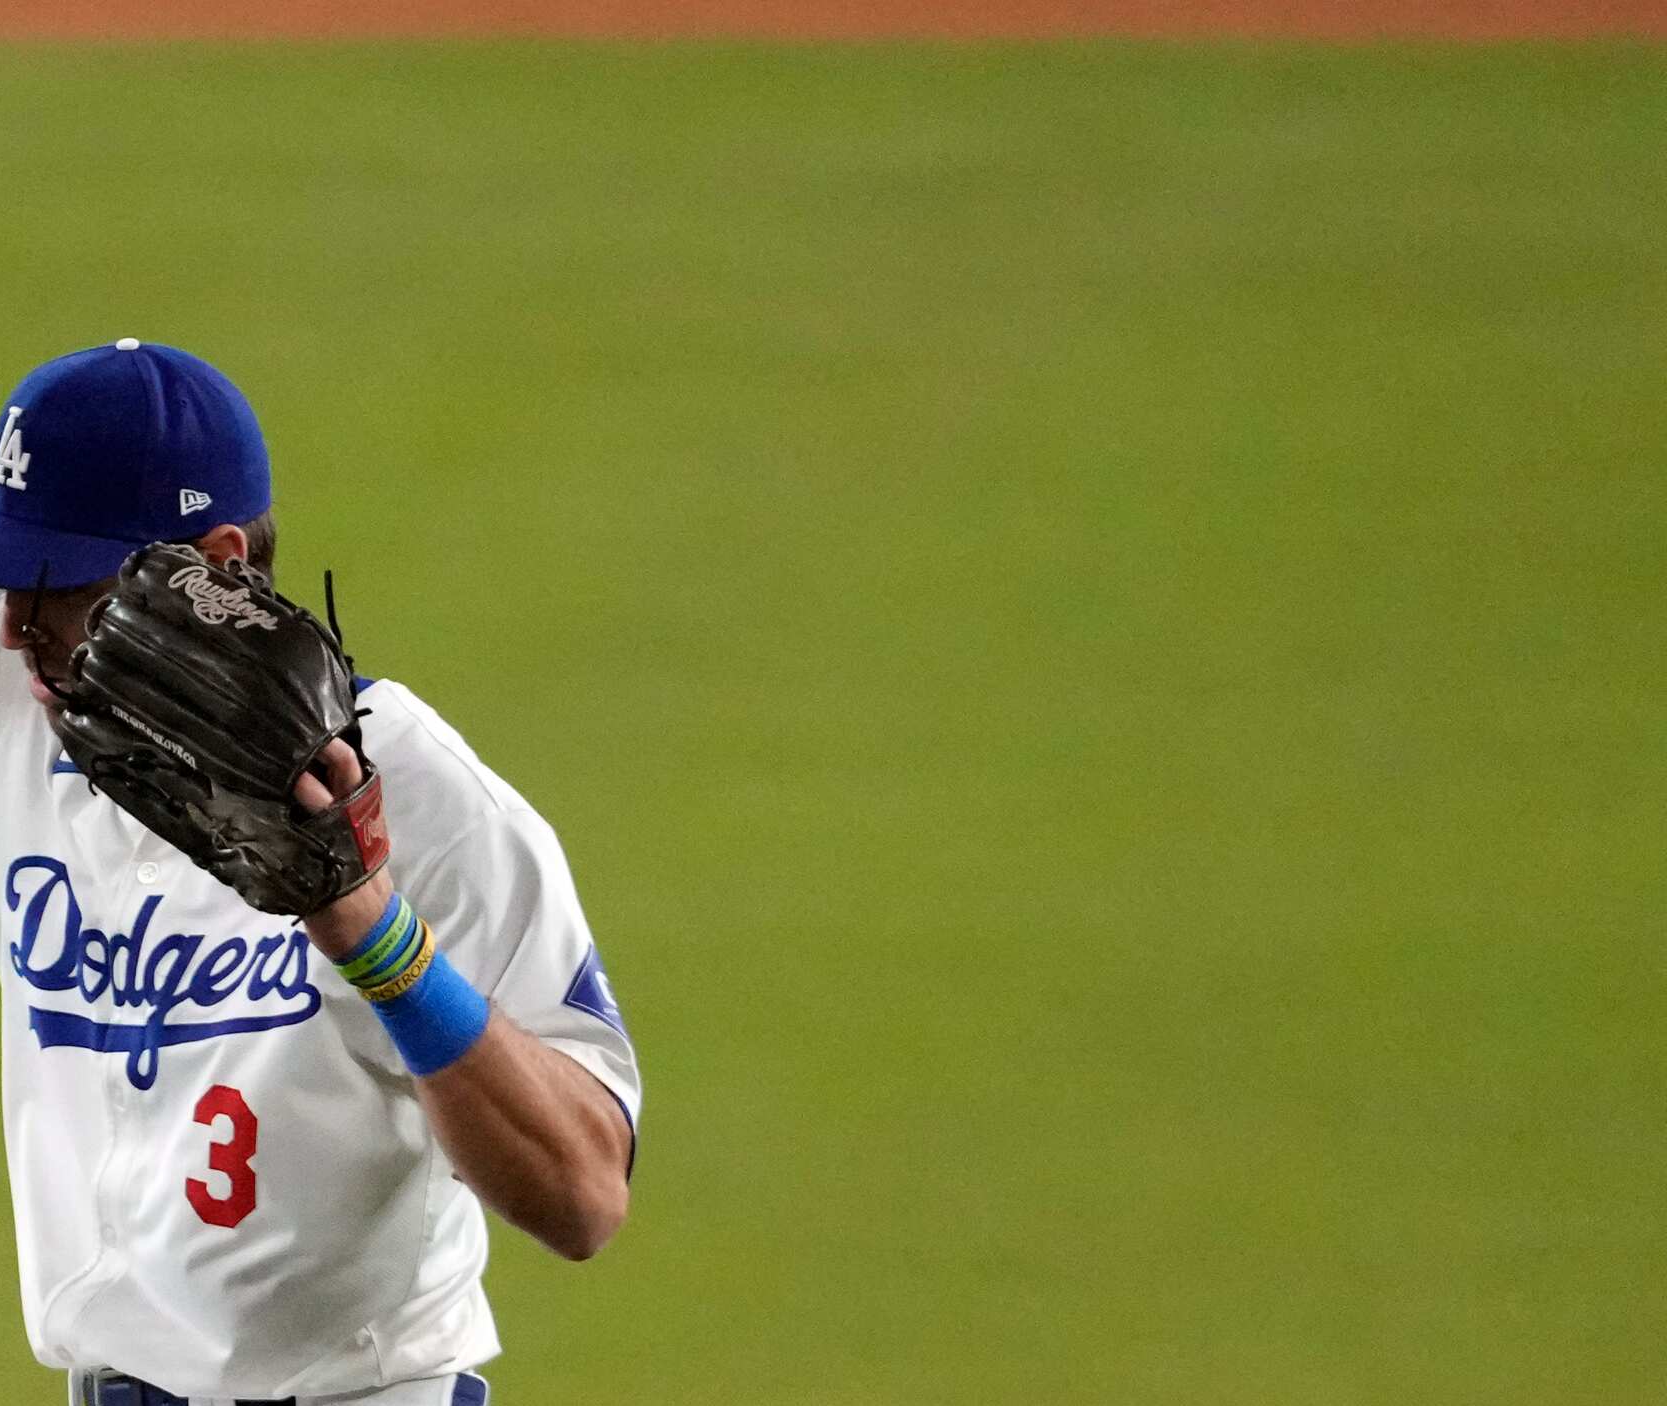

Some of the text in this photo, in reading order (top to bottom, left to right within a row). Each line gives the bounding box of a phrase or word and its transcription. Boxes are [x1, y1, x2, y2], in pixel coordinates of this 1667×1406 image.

[168, 565, 278, 631] Rawlings
[6, 855, 321, 1091] Dodgers
[185, 1084, 258, 1228] 3
